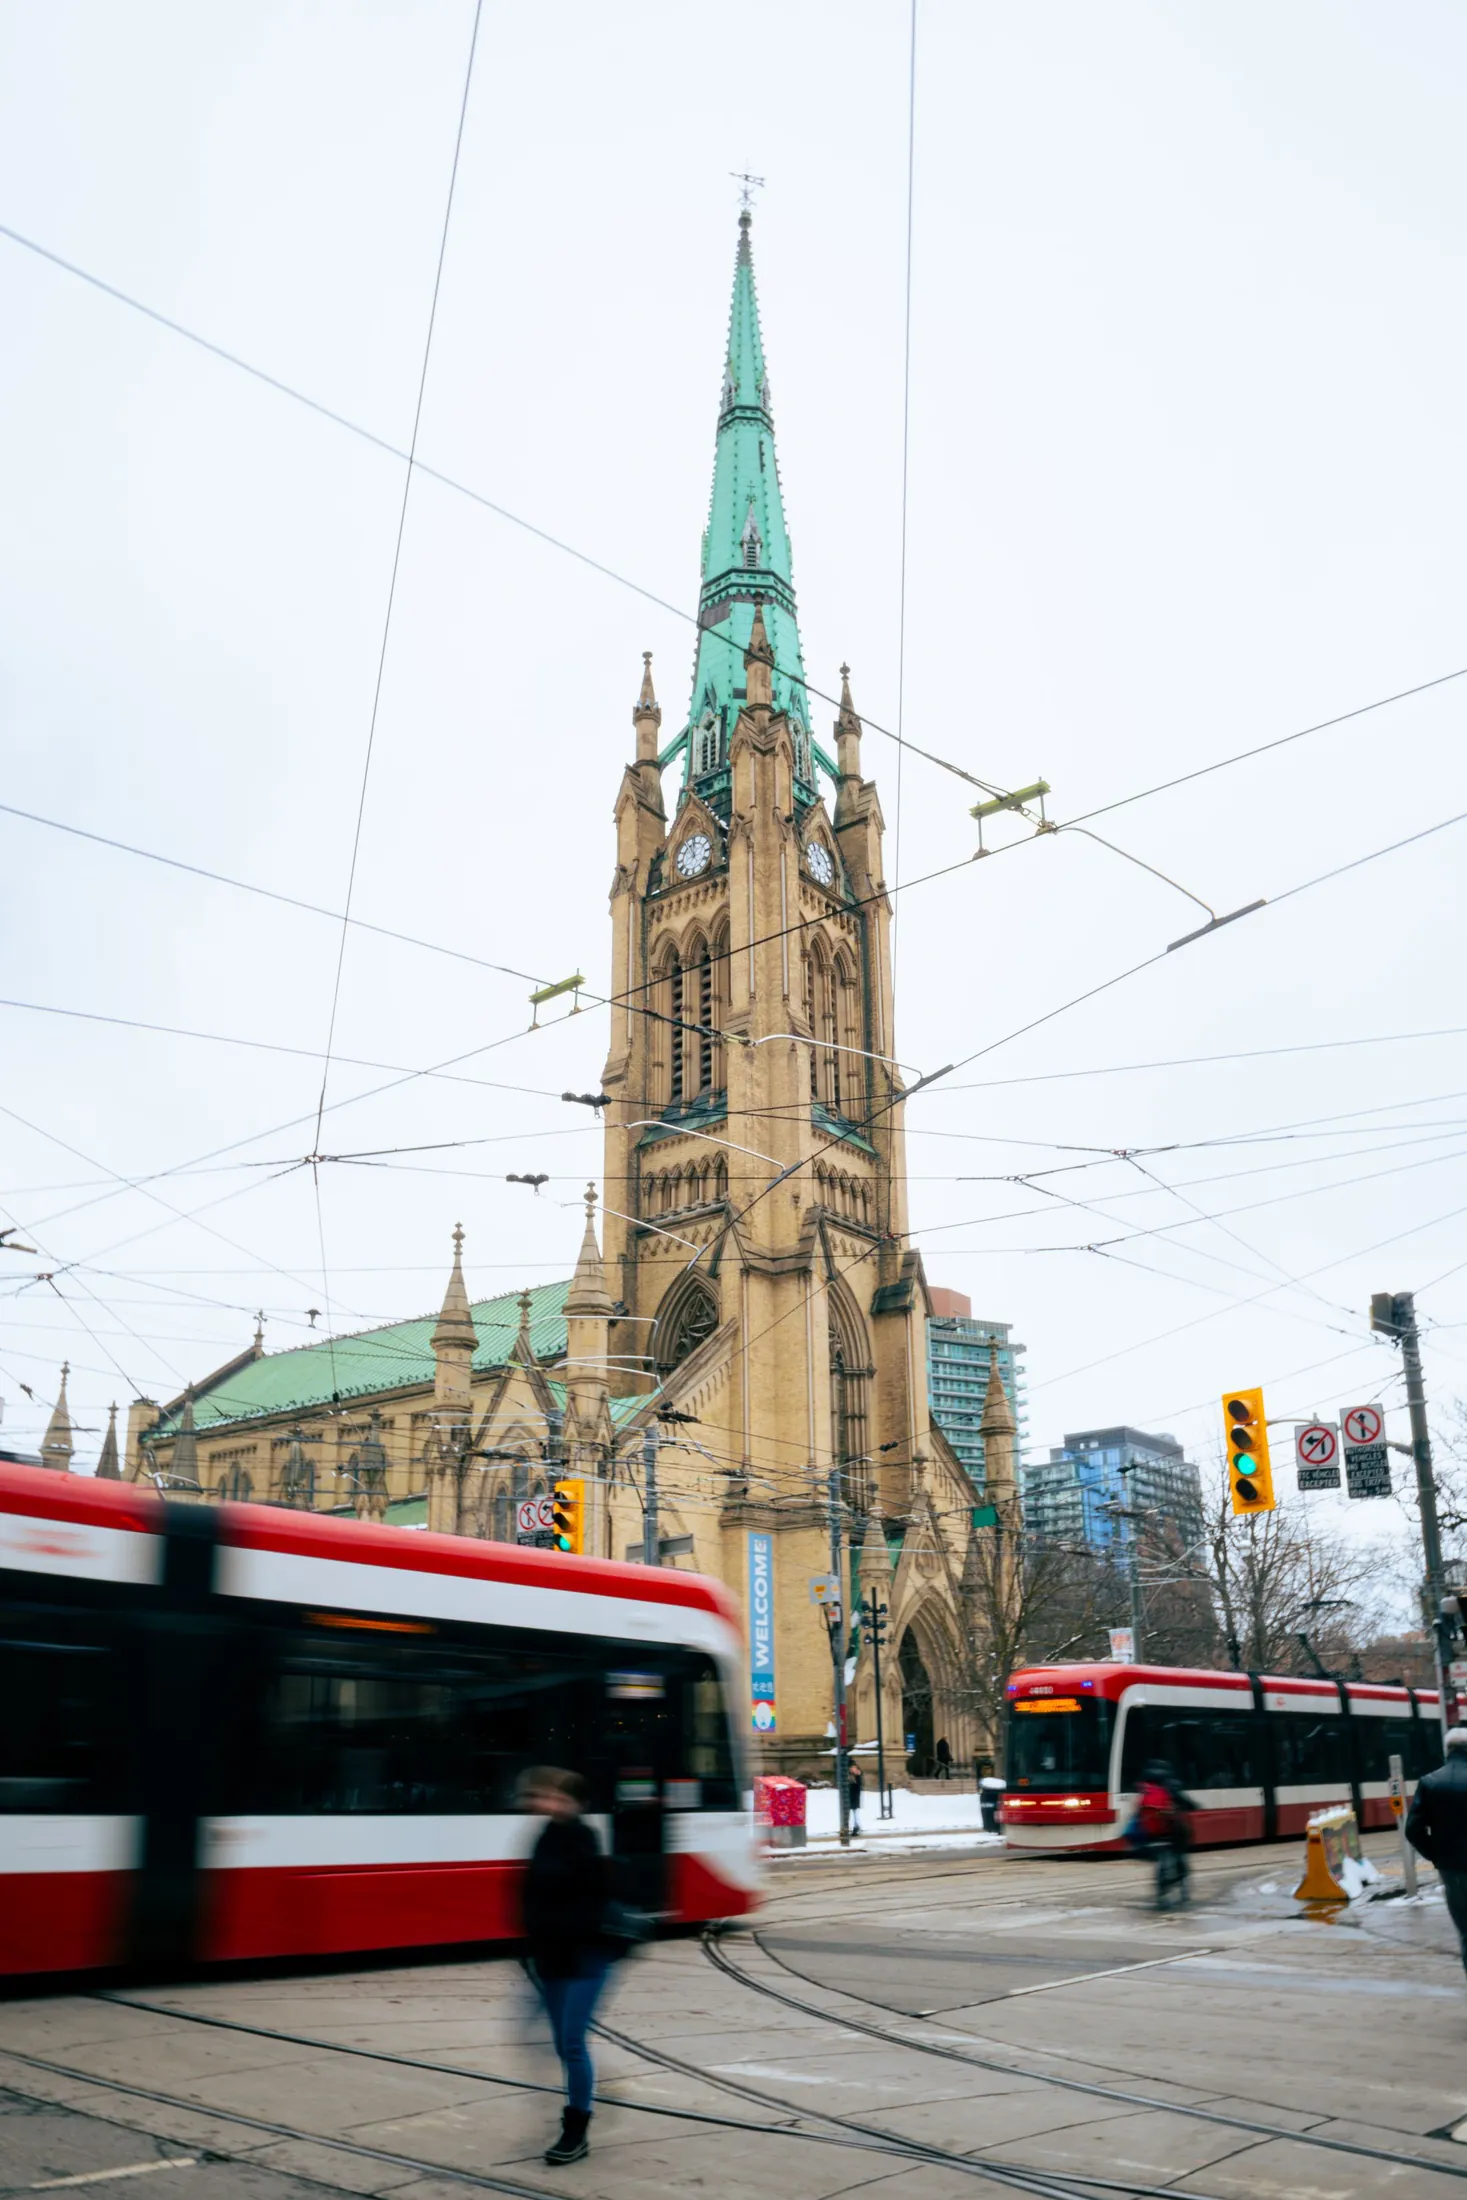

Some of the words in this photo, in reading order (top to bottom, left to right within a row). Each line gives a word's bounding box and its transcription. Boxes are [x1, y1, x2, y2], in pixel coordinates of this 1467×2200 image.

[1350, 1452, 1382, 1462] VEHICLES
[1312, 1469, 1339, 1479] VEHICLES
[1351, 1469, 1384, 1479] EXCEPTED
[1300, 1479, 1339, 1488] EXCEPTED
[754, 1539, 769, 1667] WELCOME
